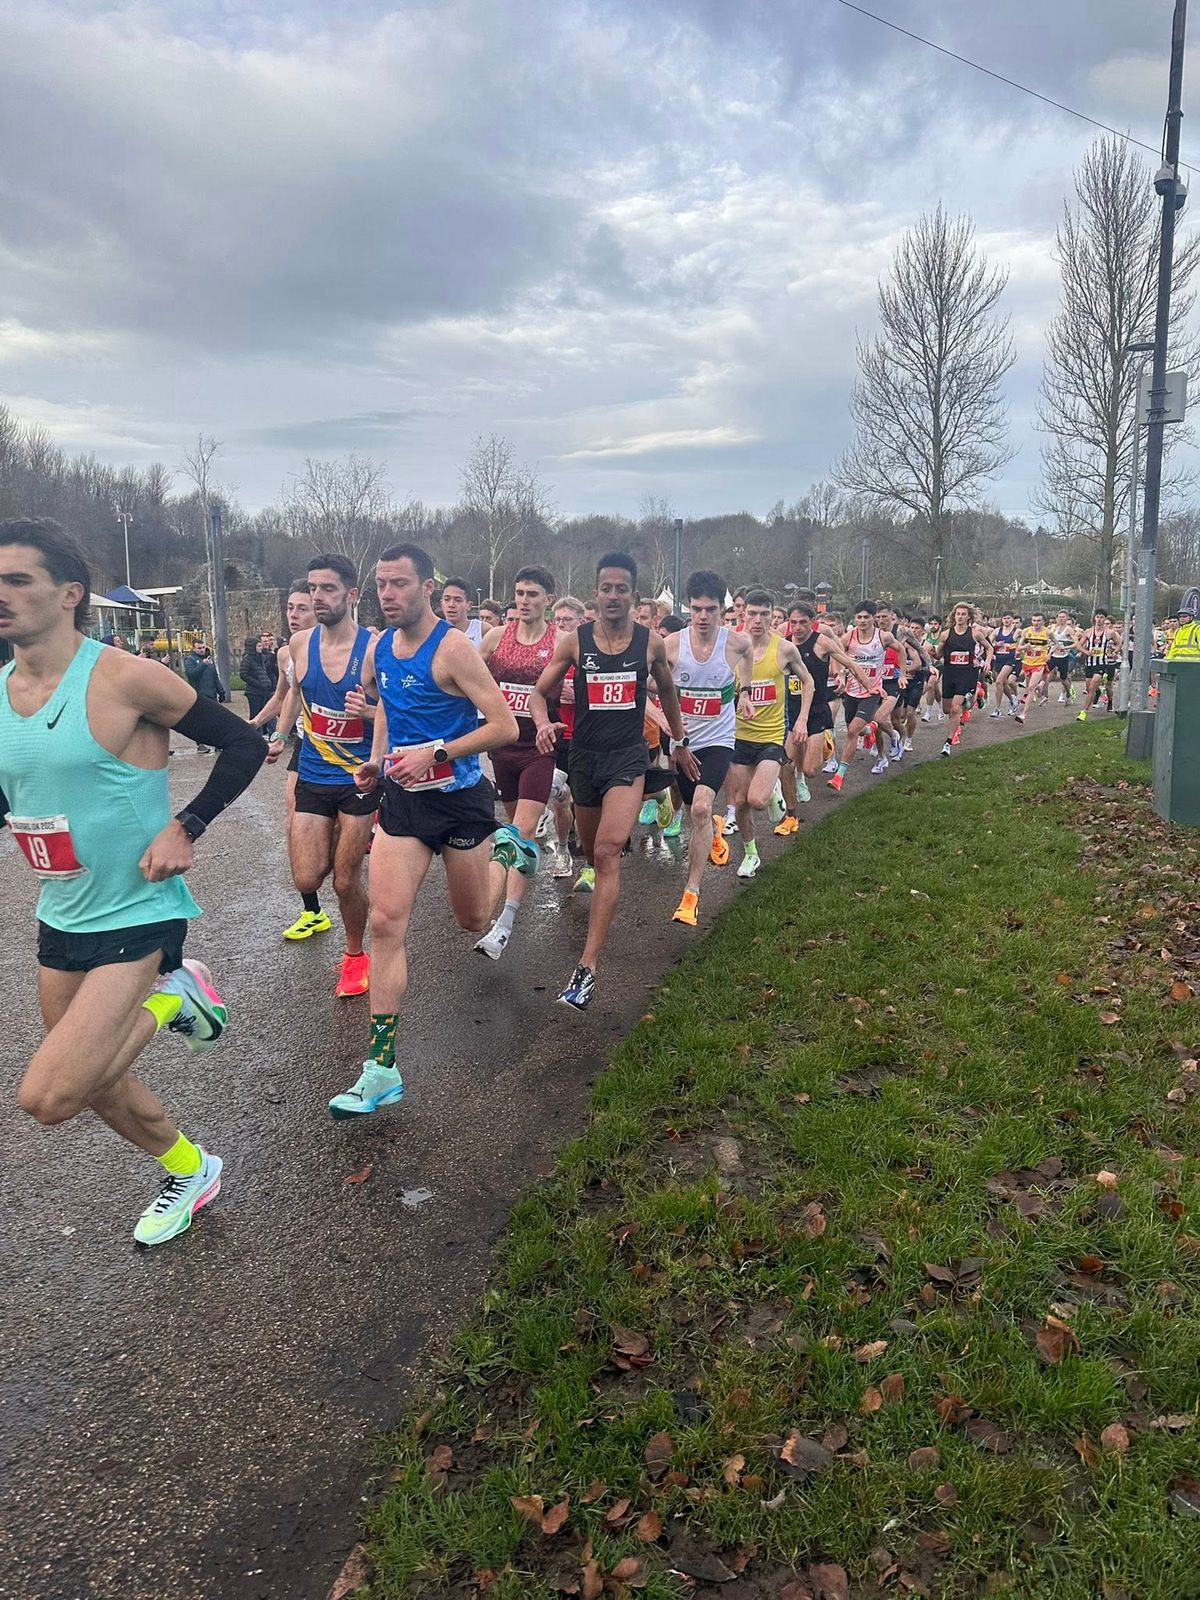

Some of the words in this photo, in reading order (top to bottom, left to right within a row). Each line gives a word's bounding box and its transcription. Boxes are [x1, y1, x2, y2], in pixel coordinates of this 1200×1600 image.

[350, 657, 360, 676] soar
[603, 683, 624, 703] 83
[750, 687, 766, 701] 101
[693, 699, 708, 715] 51
[325, 719, 347, 737] 27
[448, 836, 476, 848] HOKA
[27, 835, 52, 869] 19
